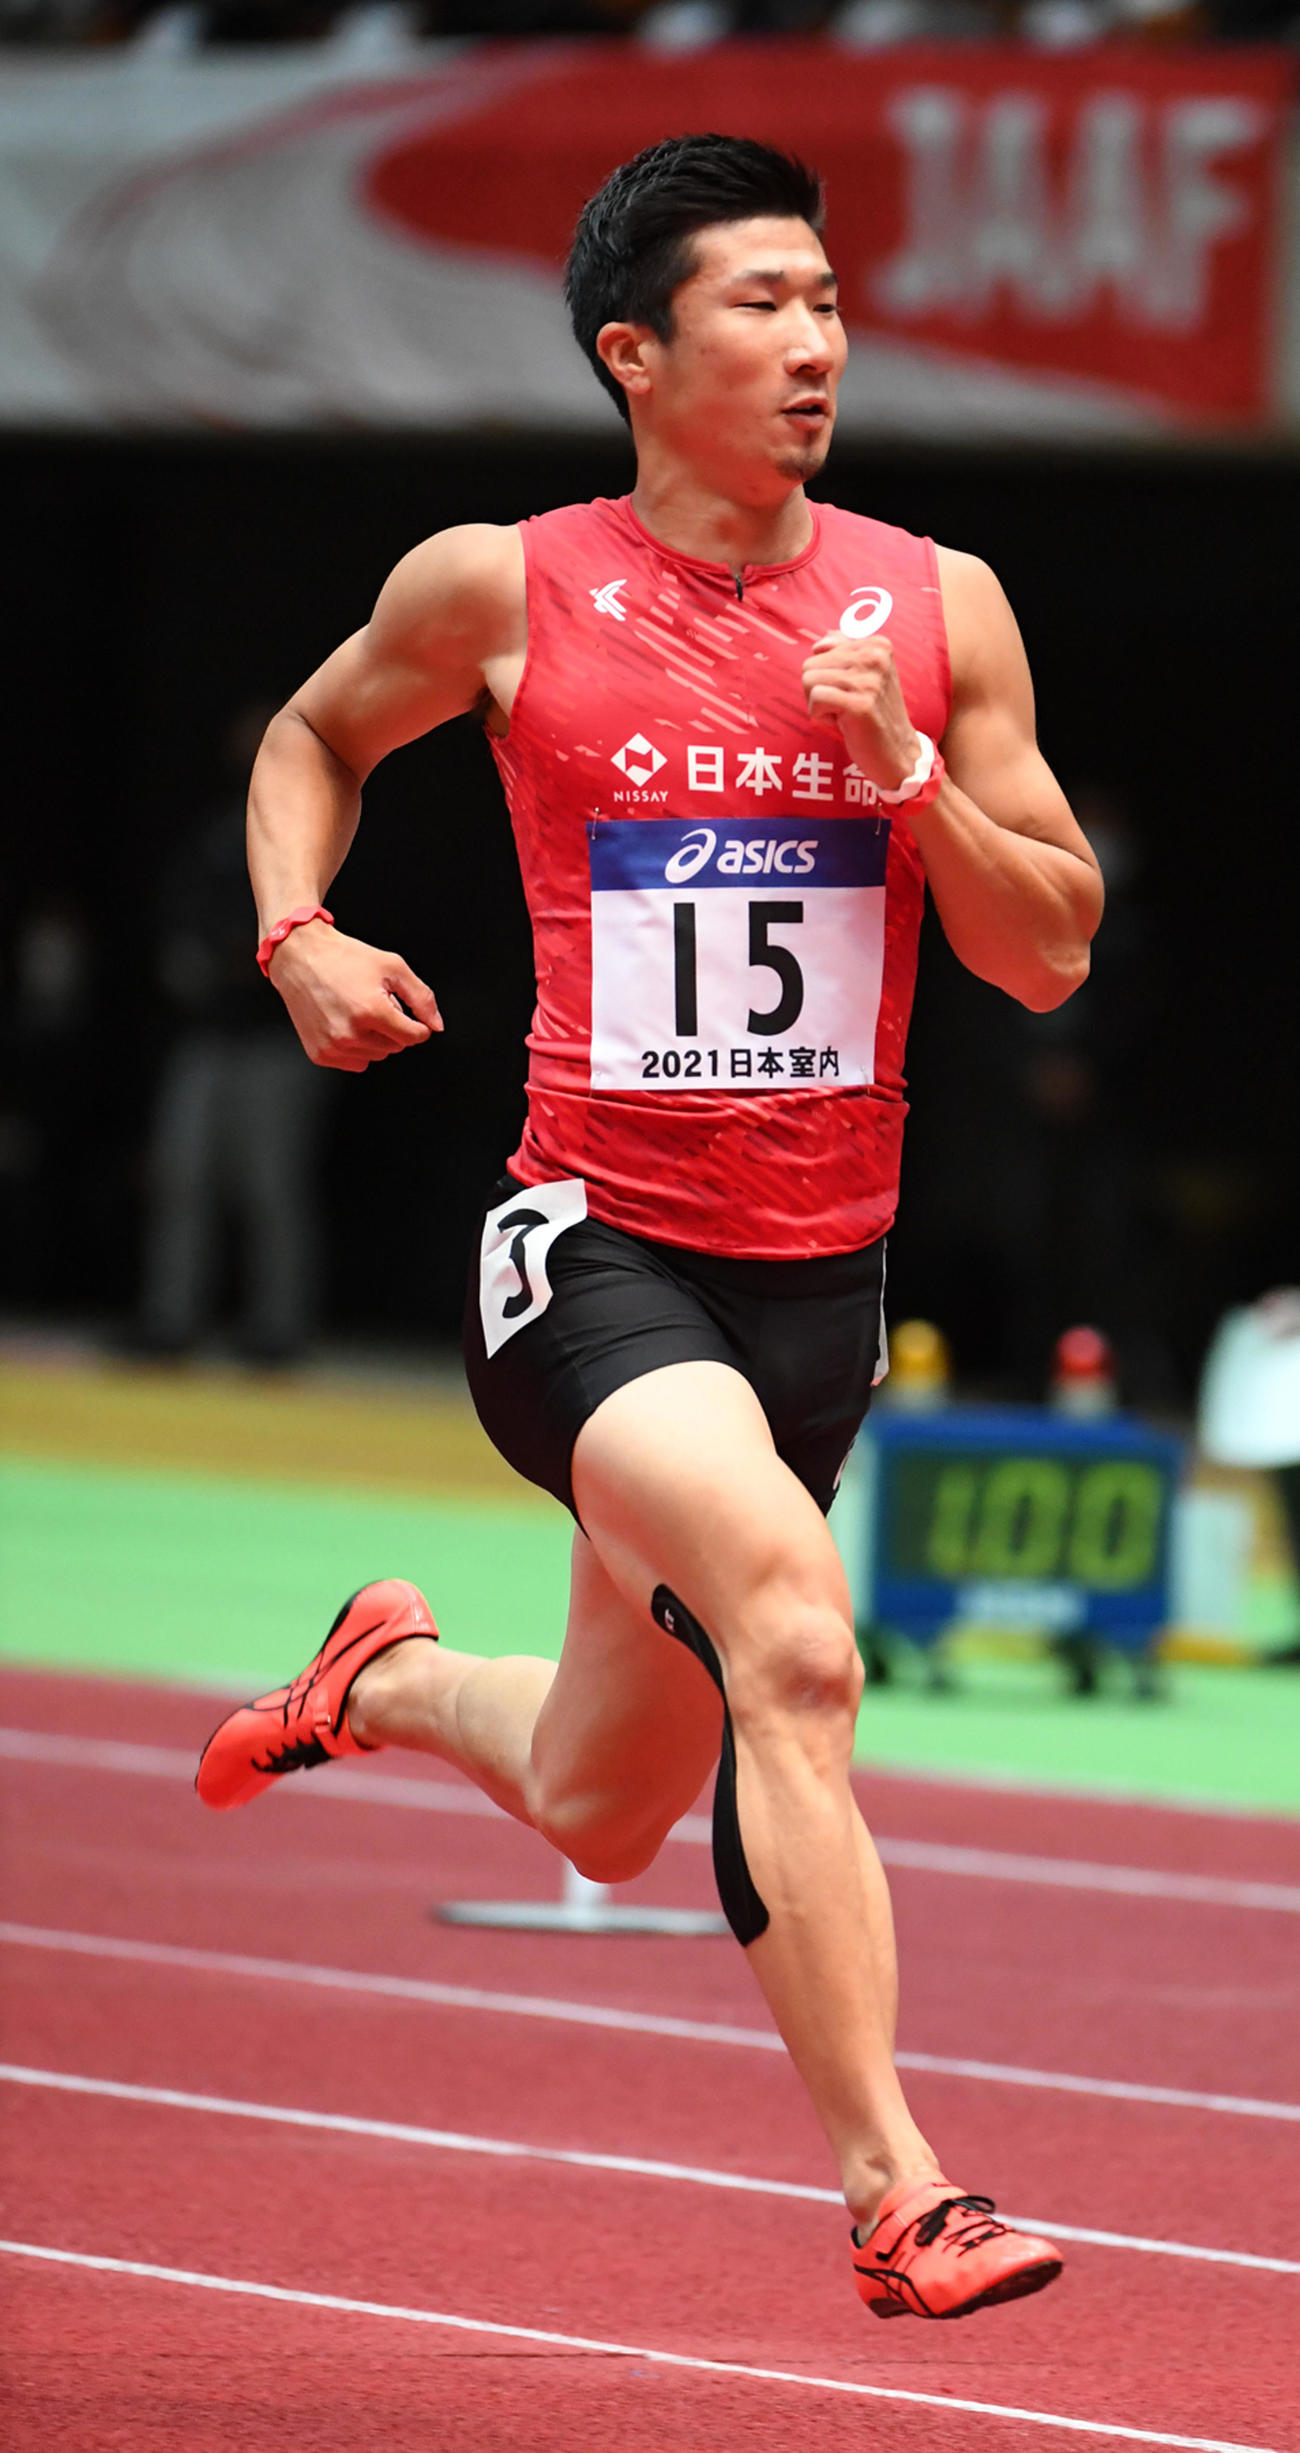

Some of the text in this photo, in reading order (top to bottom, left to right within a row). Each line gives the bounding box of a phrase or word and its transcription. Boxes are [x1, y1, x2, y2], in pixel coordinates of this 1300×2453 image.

[613, 790, 669, 803] NISSAY
[673, 900, 804, 1037] 15
[641, 1046, 840, 1080] 2021日本室内
[497, 1208, 549, 1319] 3
